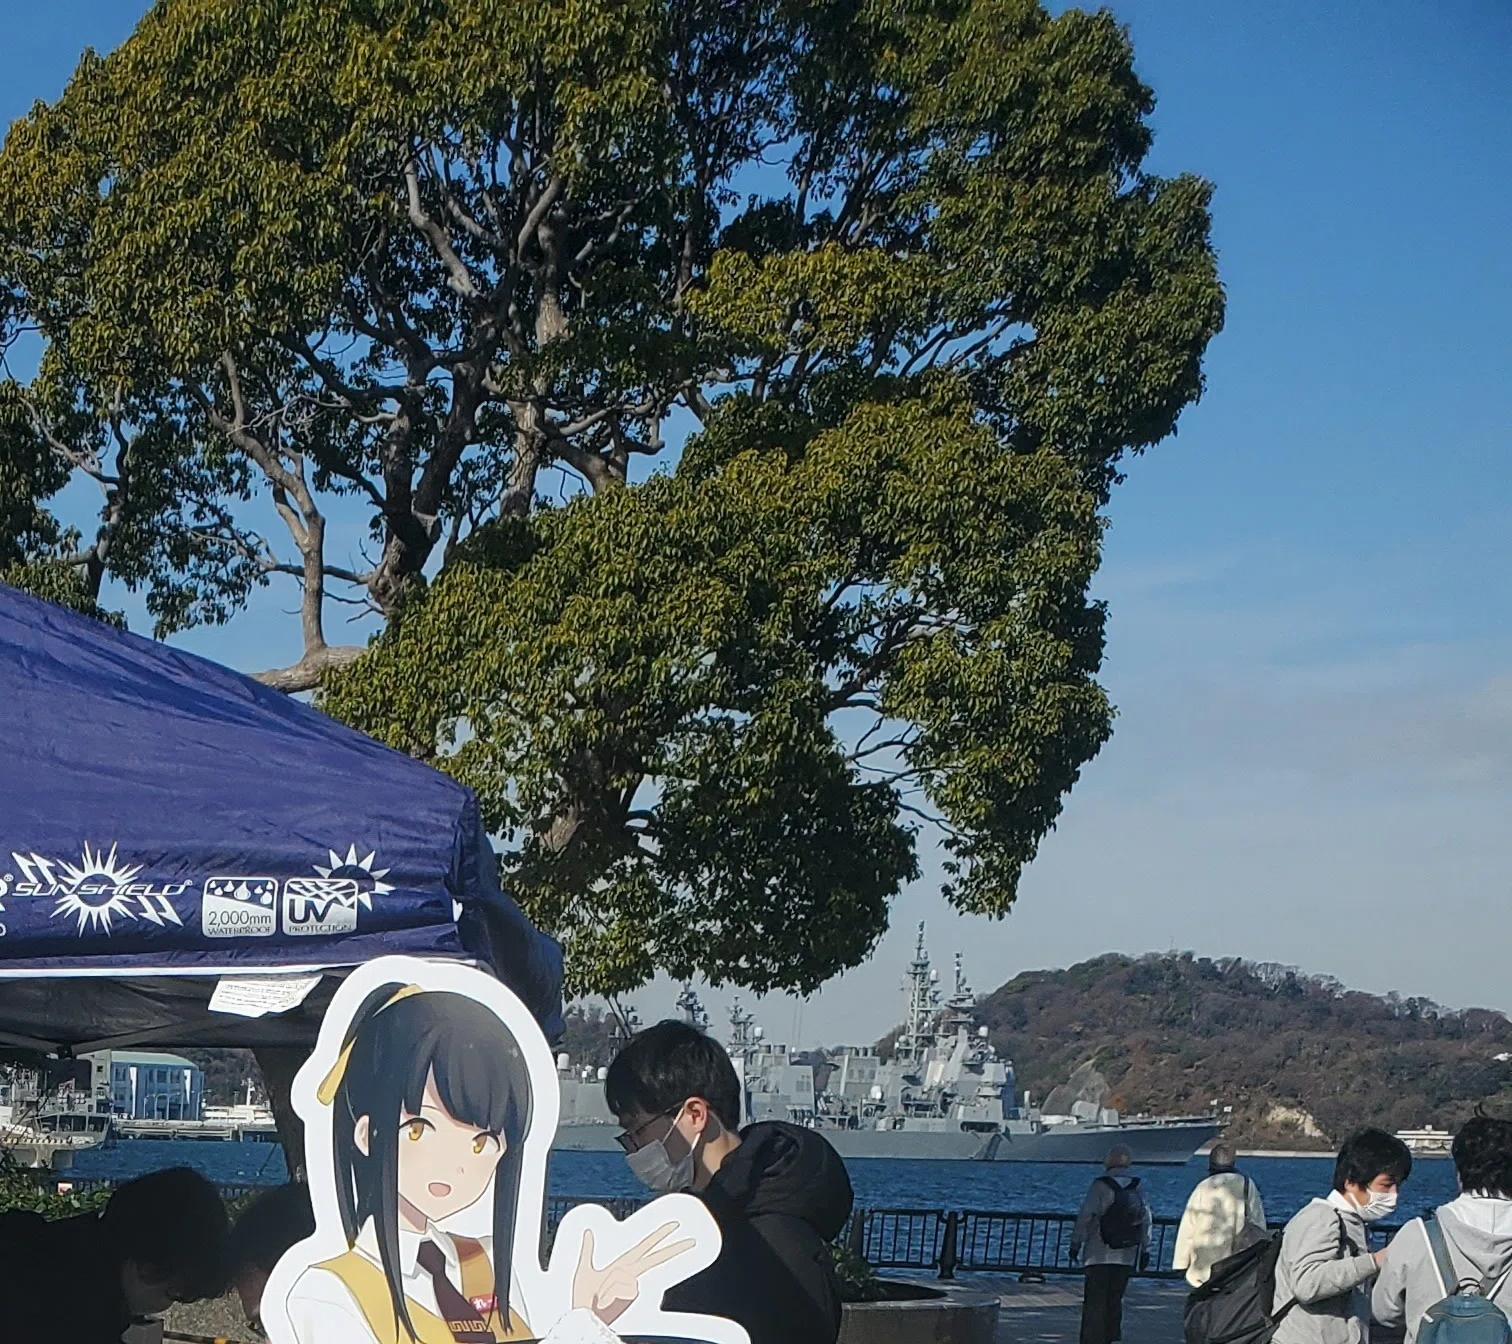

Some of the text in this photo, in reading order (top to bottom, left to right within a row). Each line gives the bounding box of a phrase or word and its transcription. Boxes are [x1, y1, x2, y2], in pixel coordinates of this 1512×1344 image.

[288, 898, 333, 924] UV
[208, 910, 271, 927] 2,000mm
[207, 926, 271, 935] WATERPROOF
[288, 924, 352, 933] PROTECTION
